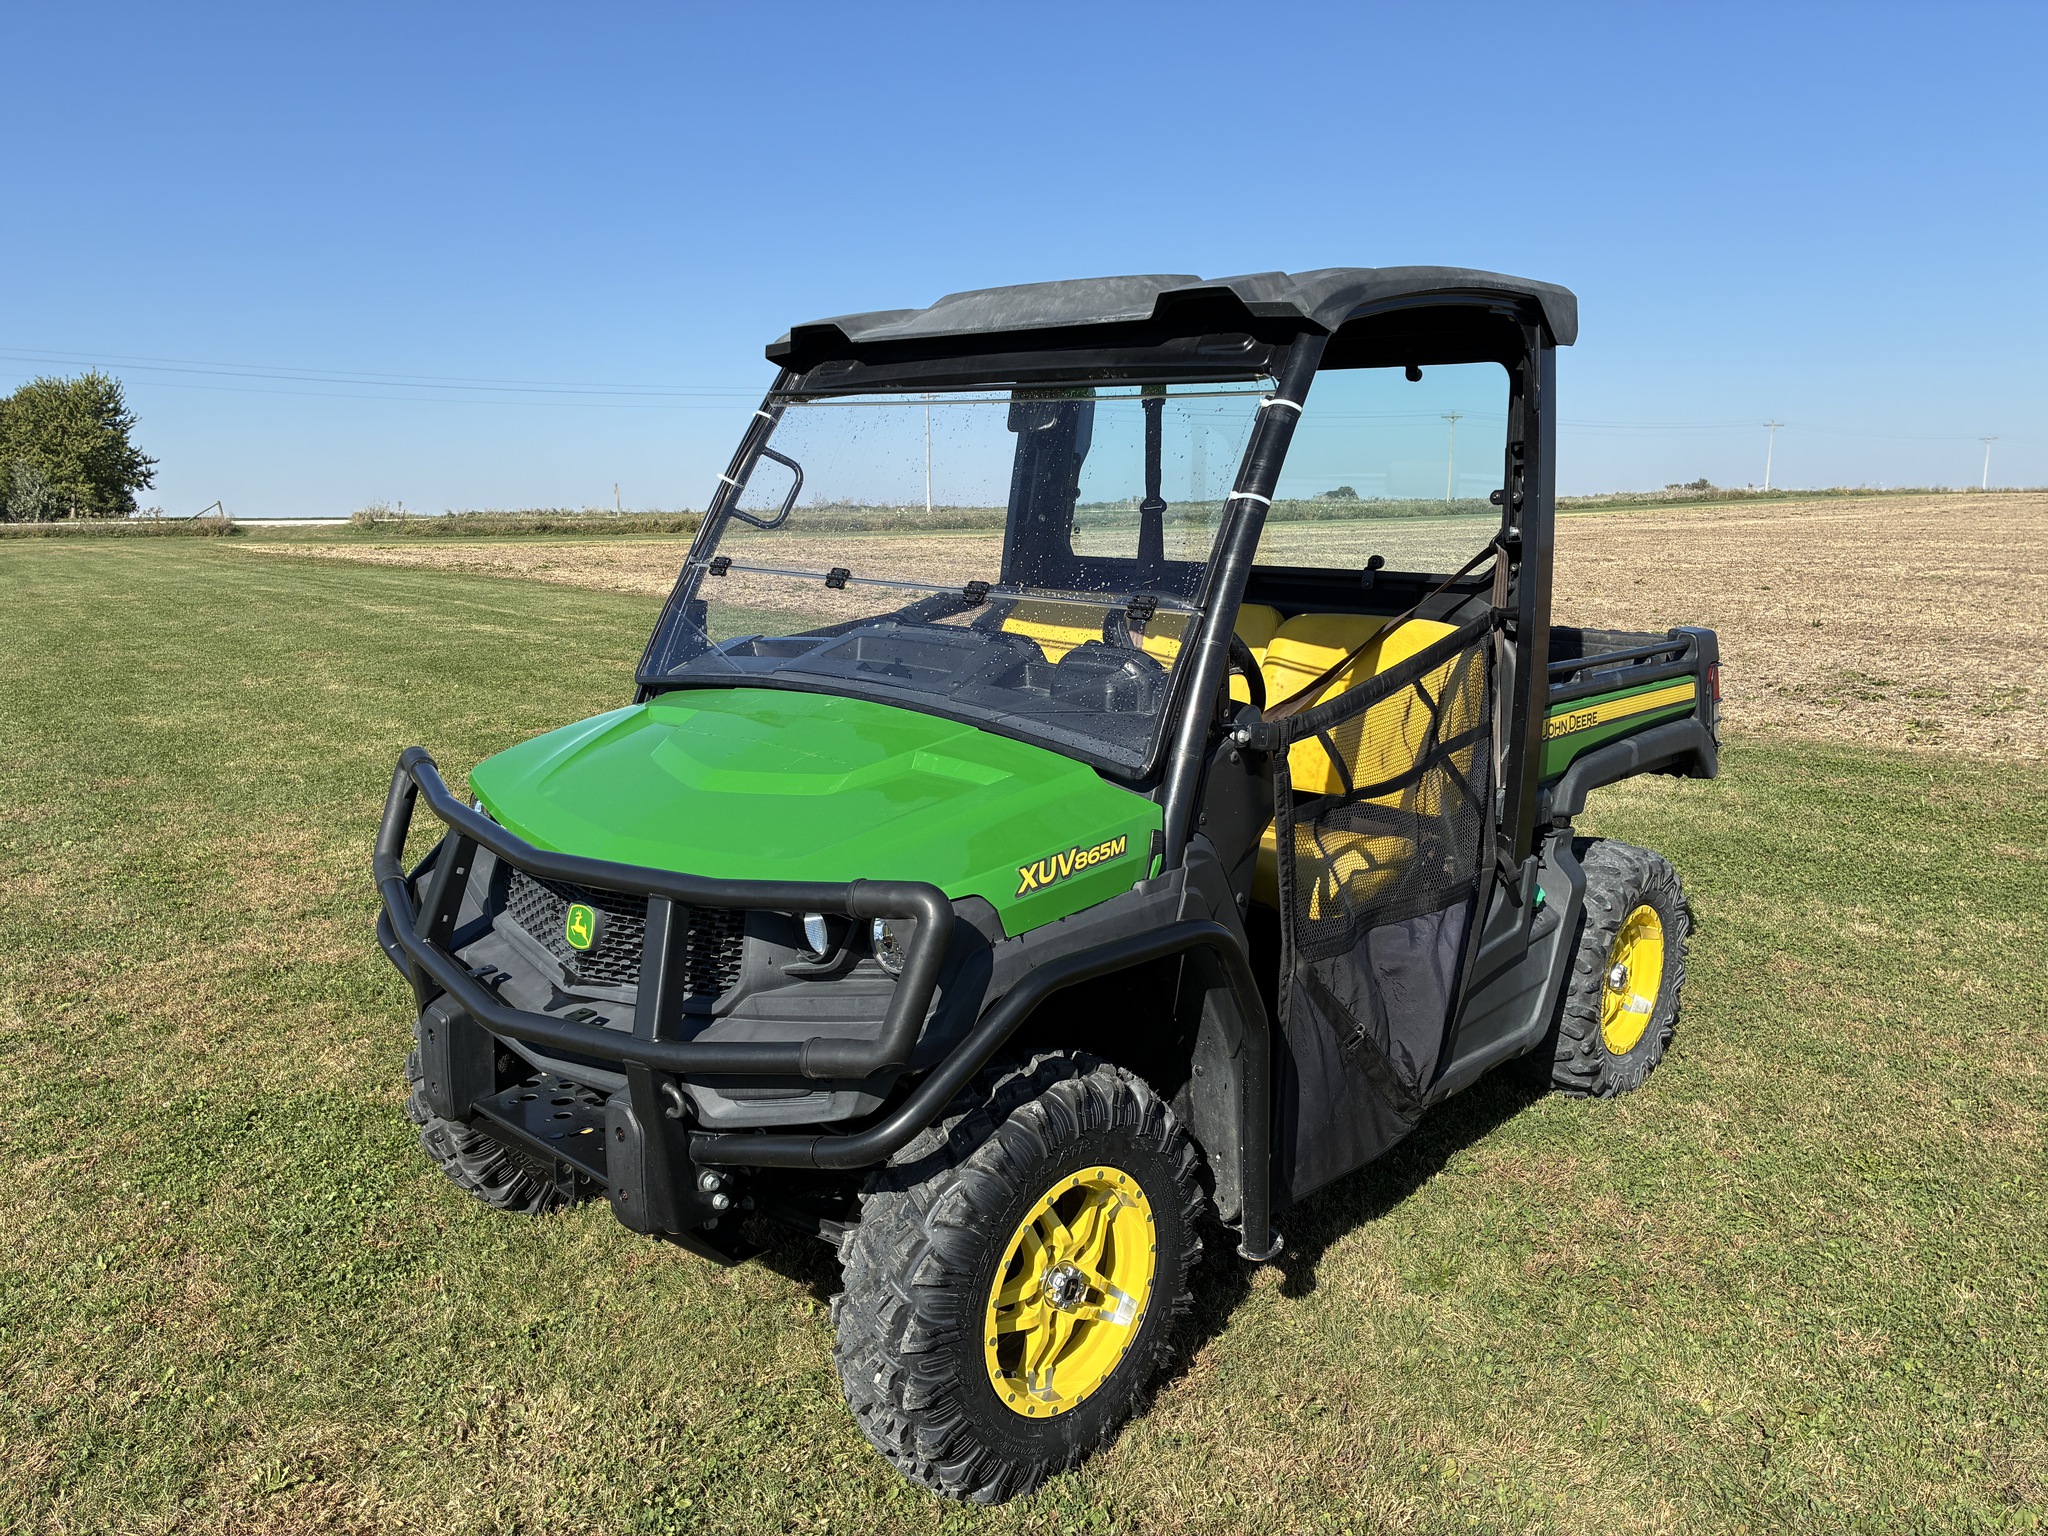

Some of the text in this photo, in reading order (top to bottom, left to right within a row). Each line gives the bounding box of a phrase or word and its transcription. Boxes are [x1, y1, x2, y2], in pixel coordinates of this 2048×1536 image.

[1542, 711, 1599, 739] JOHN DEERE
[1017, 835, 1127, 896] XUV865M
